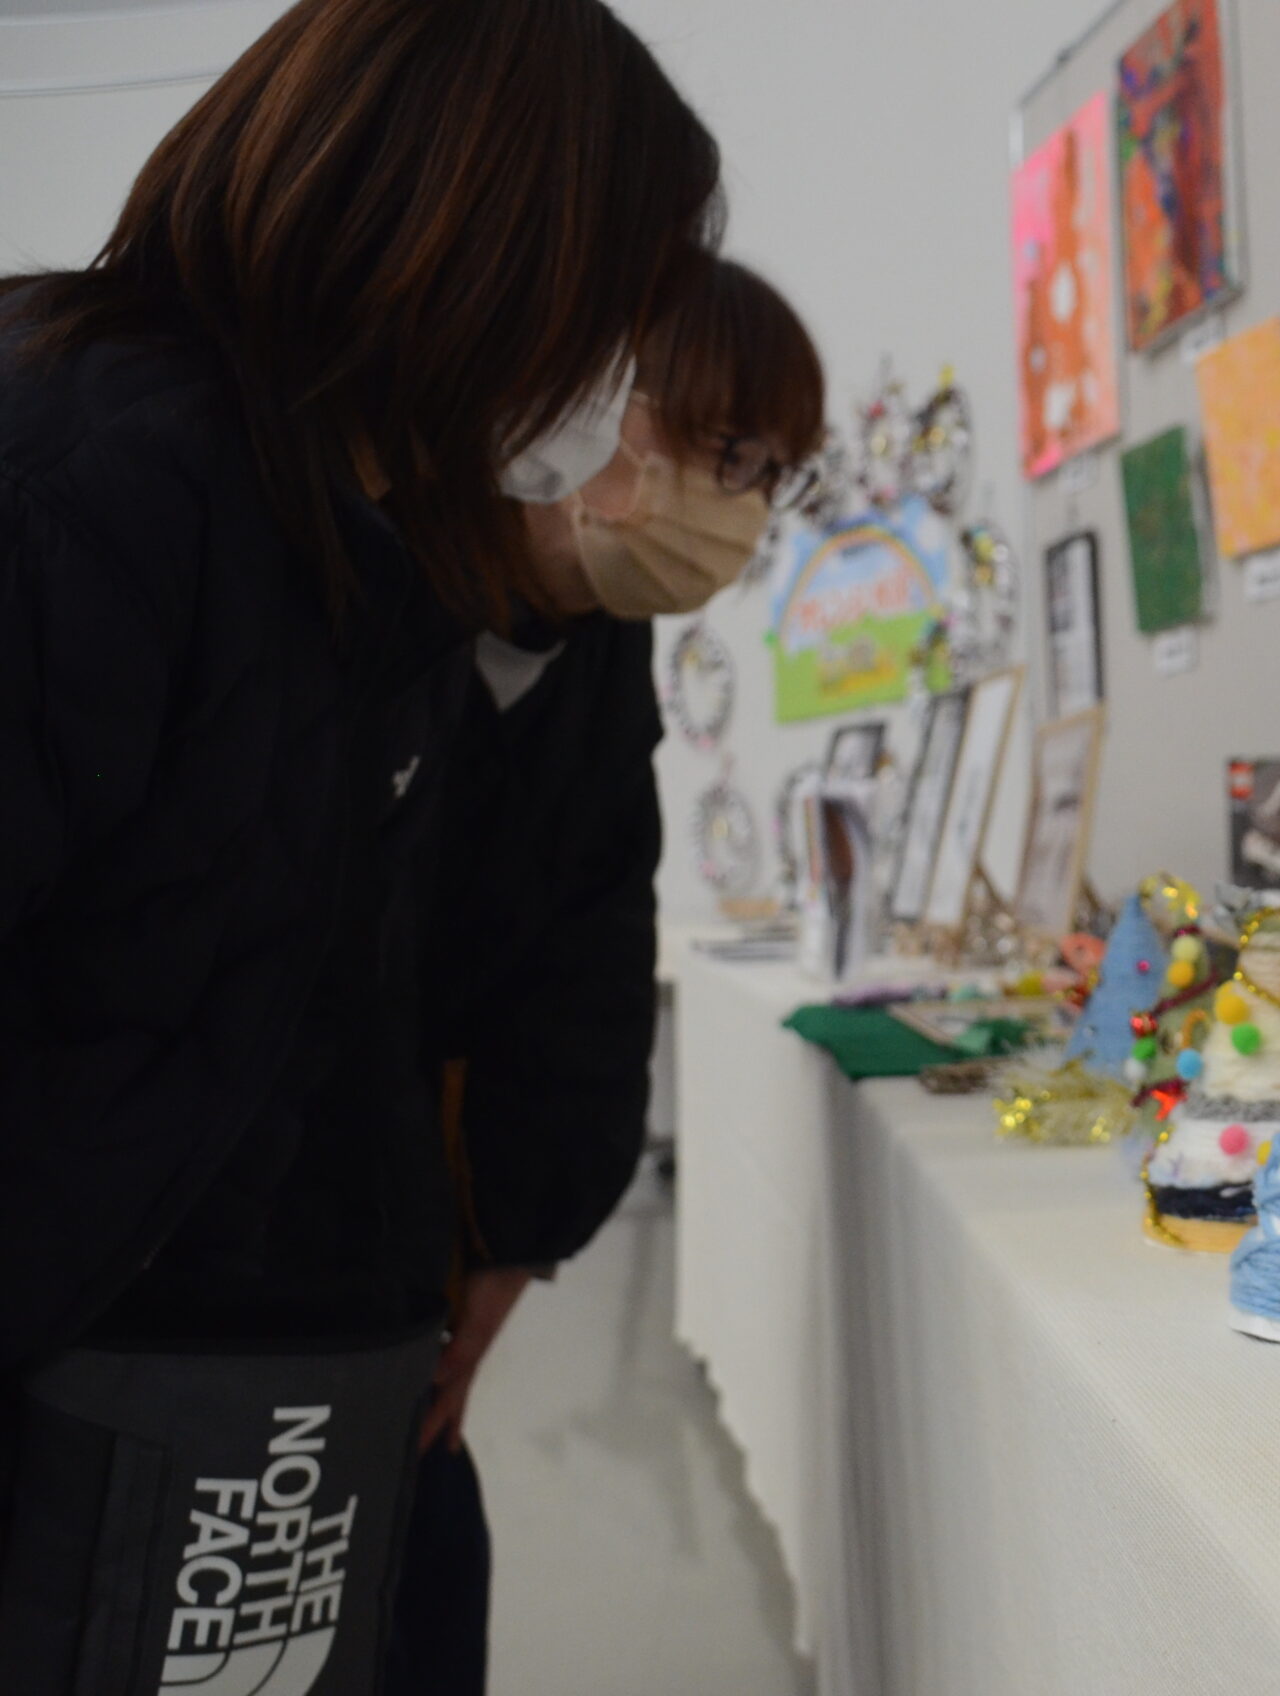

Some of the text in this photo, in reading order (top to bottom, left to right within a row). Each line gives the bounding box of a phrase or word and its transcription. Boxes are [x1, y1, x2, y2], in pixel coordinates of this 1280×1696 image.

[167, 1477, 259, 1650] FACE
[233, 1404, 331, 1646] NORTH
[291, 1494, 357, 1632] THE
